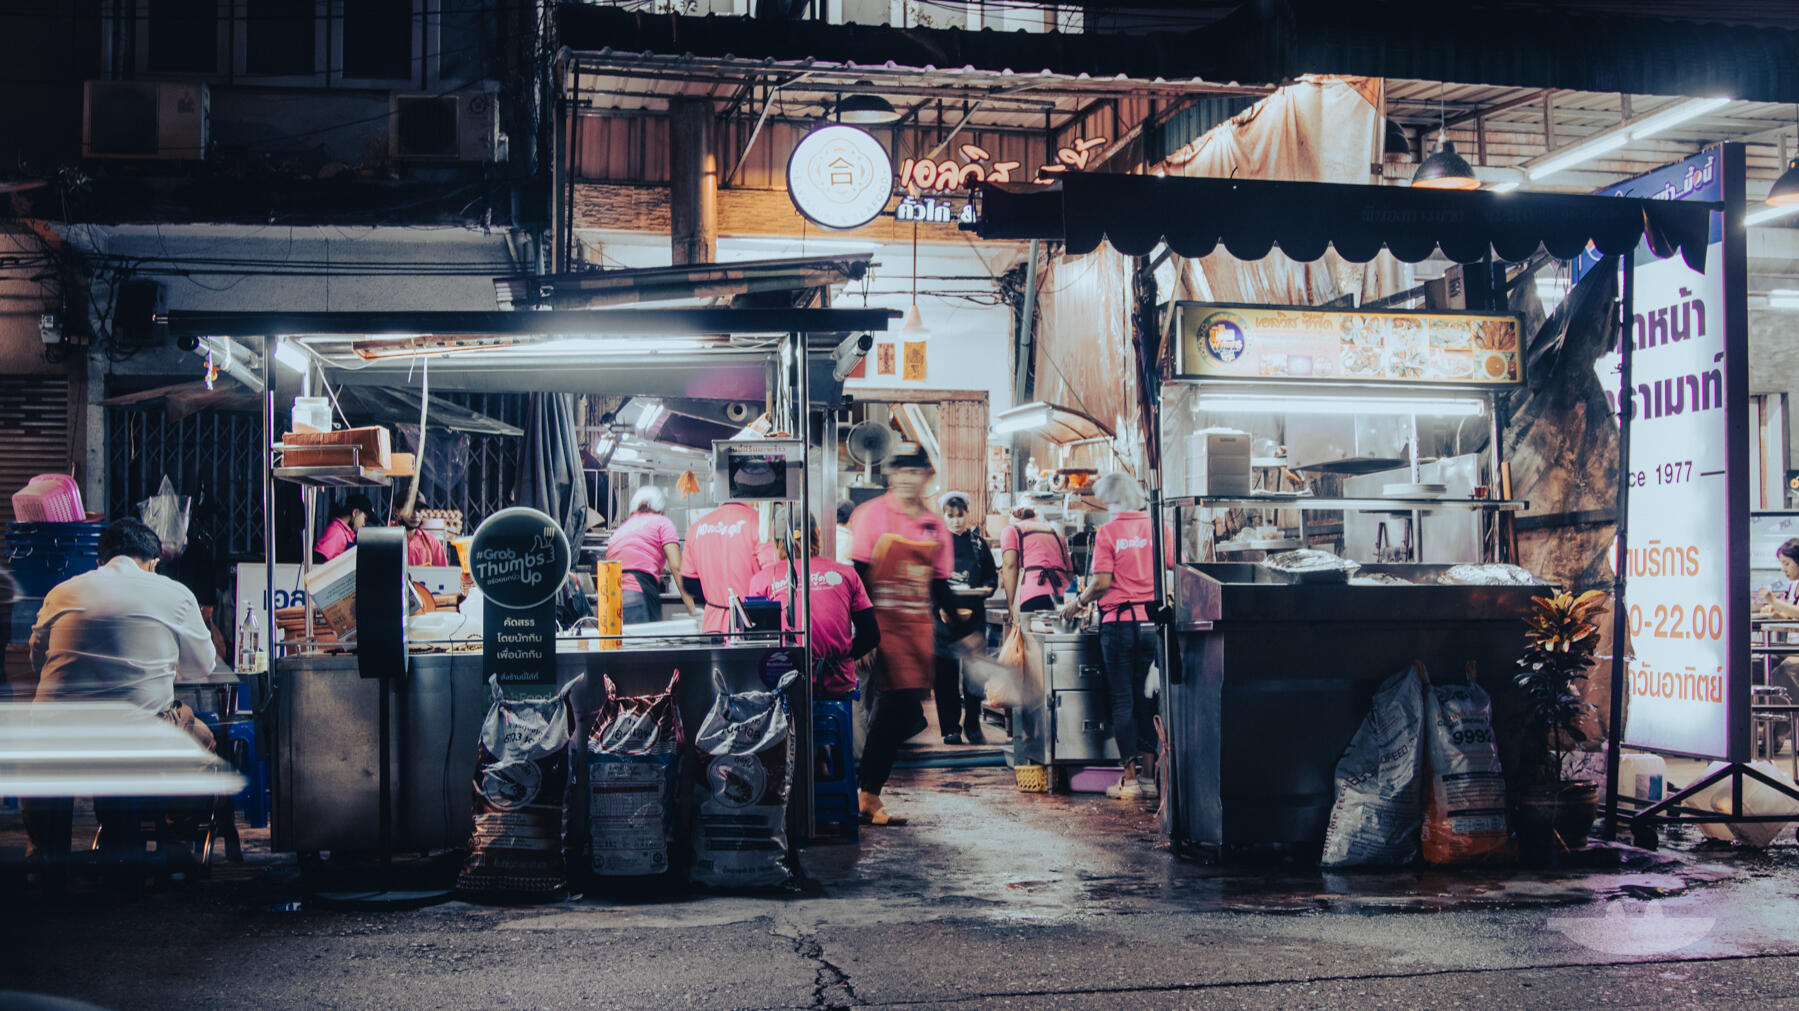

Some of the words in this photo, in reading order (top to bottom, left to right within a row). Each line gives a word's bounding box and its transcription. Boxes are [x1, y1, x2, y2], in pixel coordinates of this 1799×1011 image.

[1655, 461, 1693, 485] 1977
[476, 548, 516, 561] #Grab
[476, 552, 545, 579] Thumbs
[521, 569, 543, 587] Up
[503, 616, 536, 628] คัดสรร
[1630, 604, 1723, 641] 0-22.00
